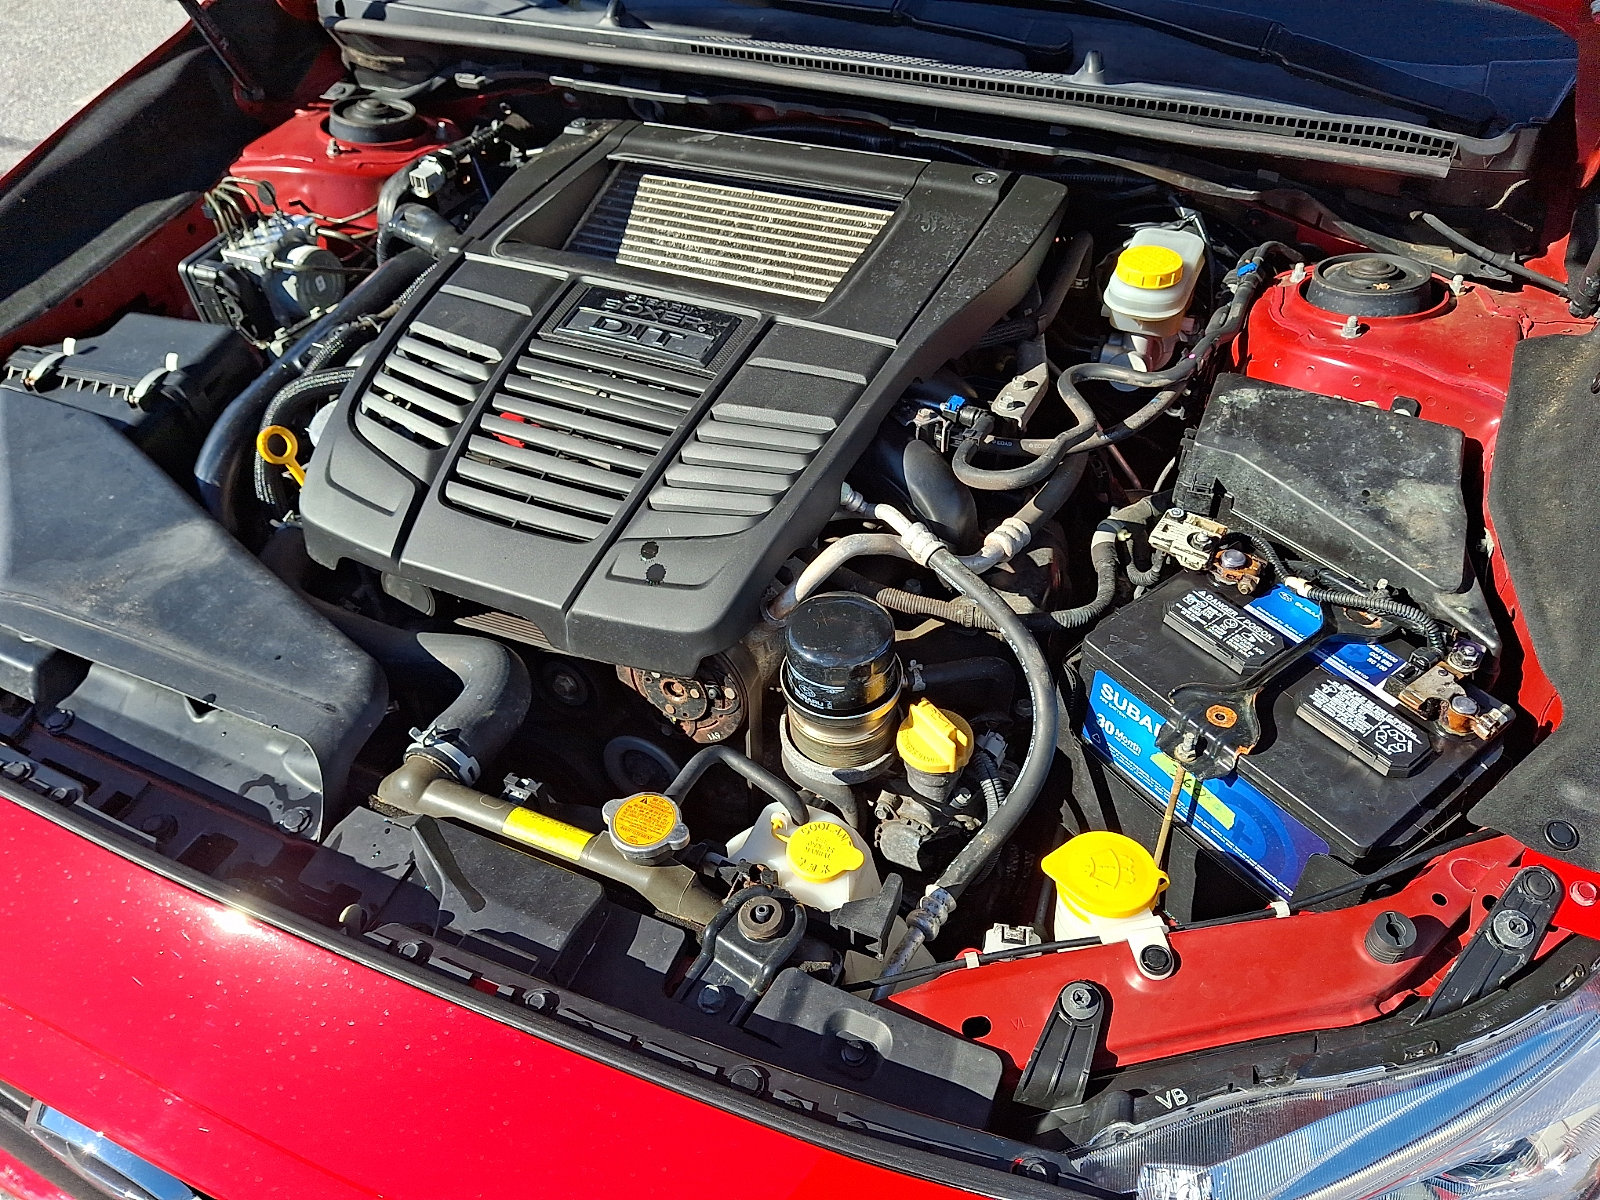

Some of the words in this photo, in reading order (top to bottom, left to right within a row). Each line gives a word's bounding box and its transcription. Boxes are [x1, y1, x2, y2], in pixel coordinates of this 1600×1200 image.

[601, 298, 703, 325] BOXER
[625, 294, 694, 315] SUBARU
[589, 316, 688, 347] DIT
[1205, 594, 1239, 617] DANGER
[1243, 618, 1275, 641] POISON
[1368, 651, 1381, 661] CCA
[1096, 713, 1115, 736] 30
[1115, 728, 1142, 752] Month
[1155, 1088, 1189, 1109] VB
